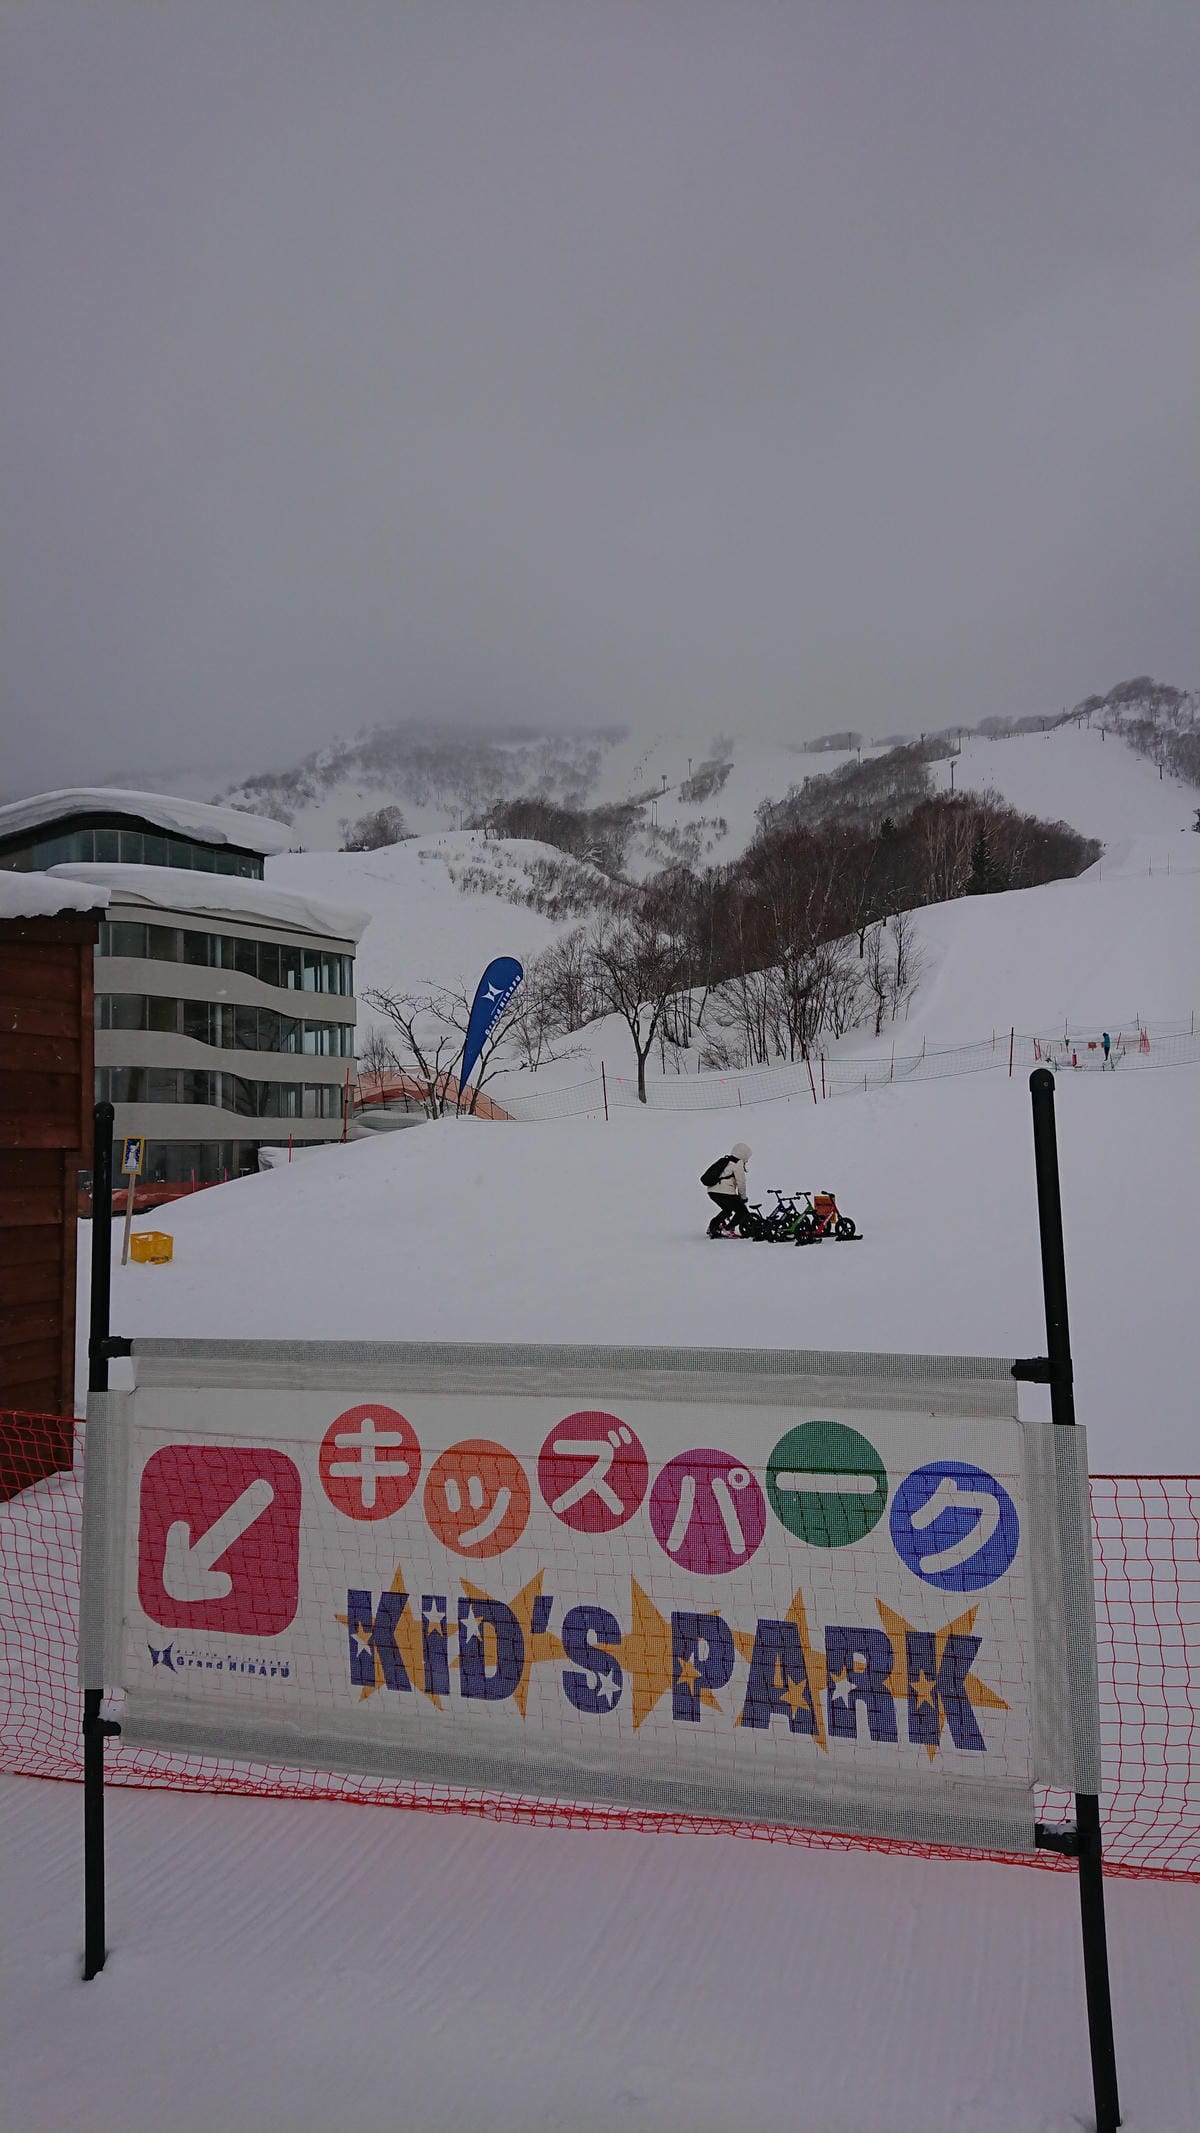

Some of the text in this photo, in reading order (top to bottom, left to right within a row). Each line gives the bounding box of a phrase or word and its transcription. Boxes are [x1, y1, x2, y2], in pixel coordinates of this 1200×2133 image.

[500, 975, 521, 1008] HIRAFU
[327, 1416, 1001, 1576] キッズパーク
[176, 1656, 223, 1670] Grand
[229, 1661, 290, 1678] HIRAFU
[671, 1610, 988, 1752] PARK
